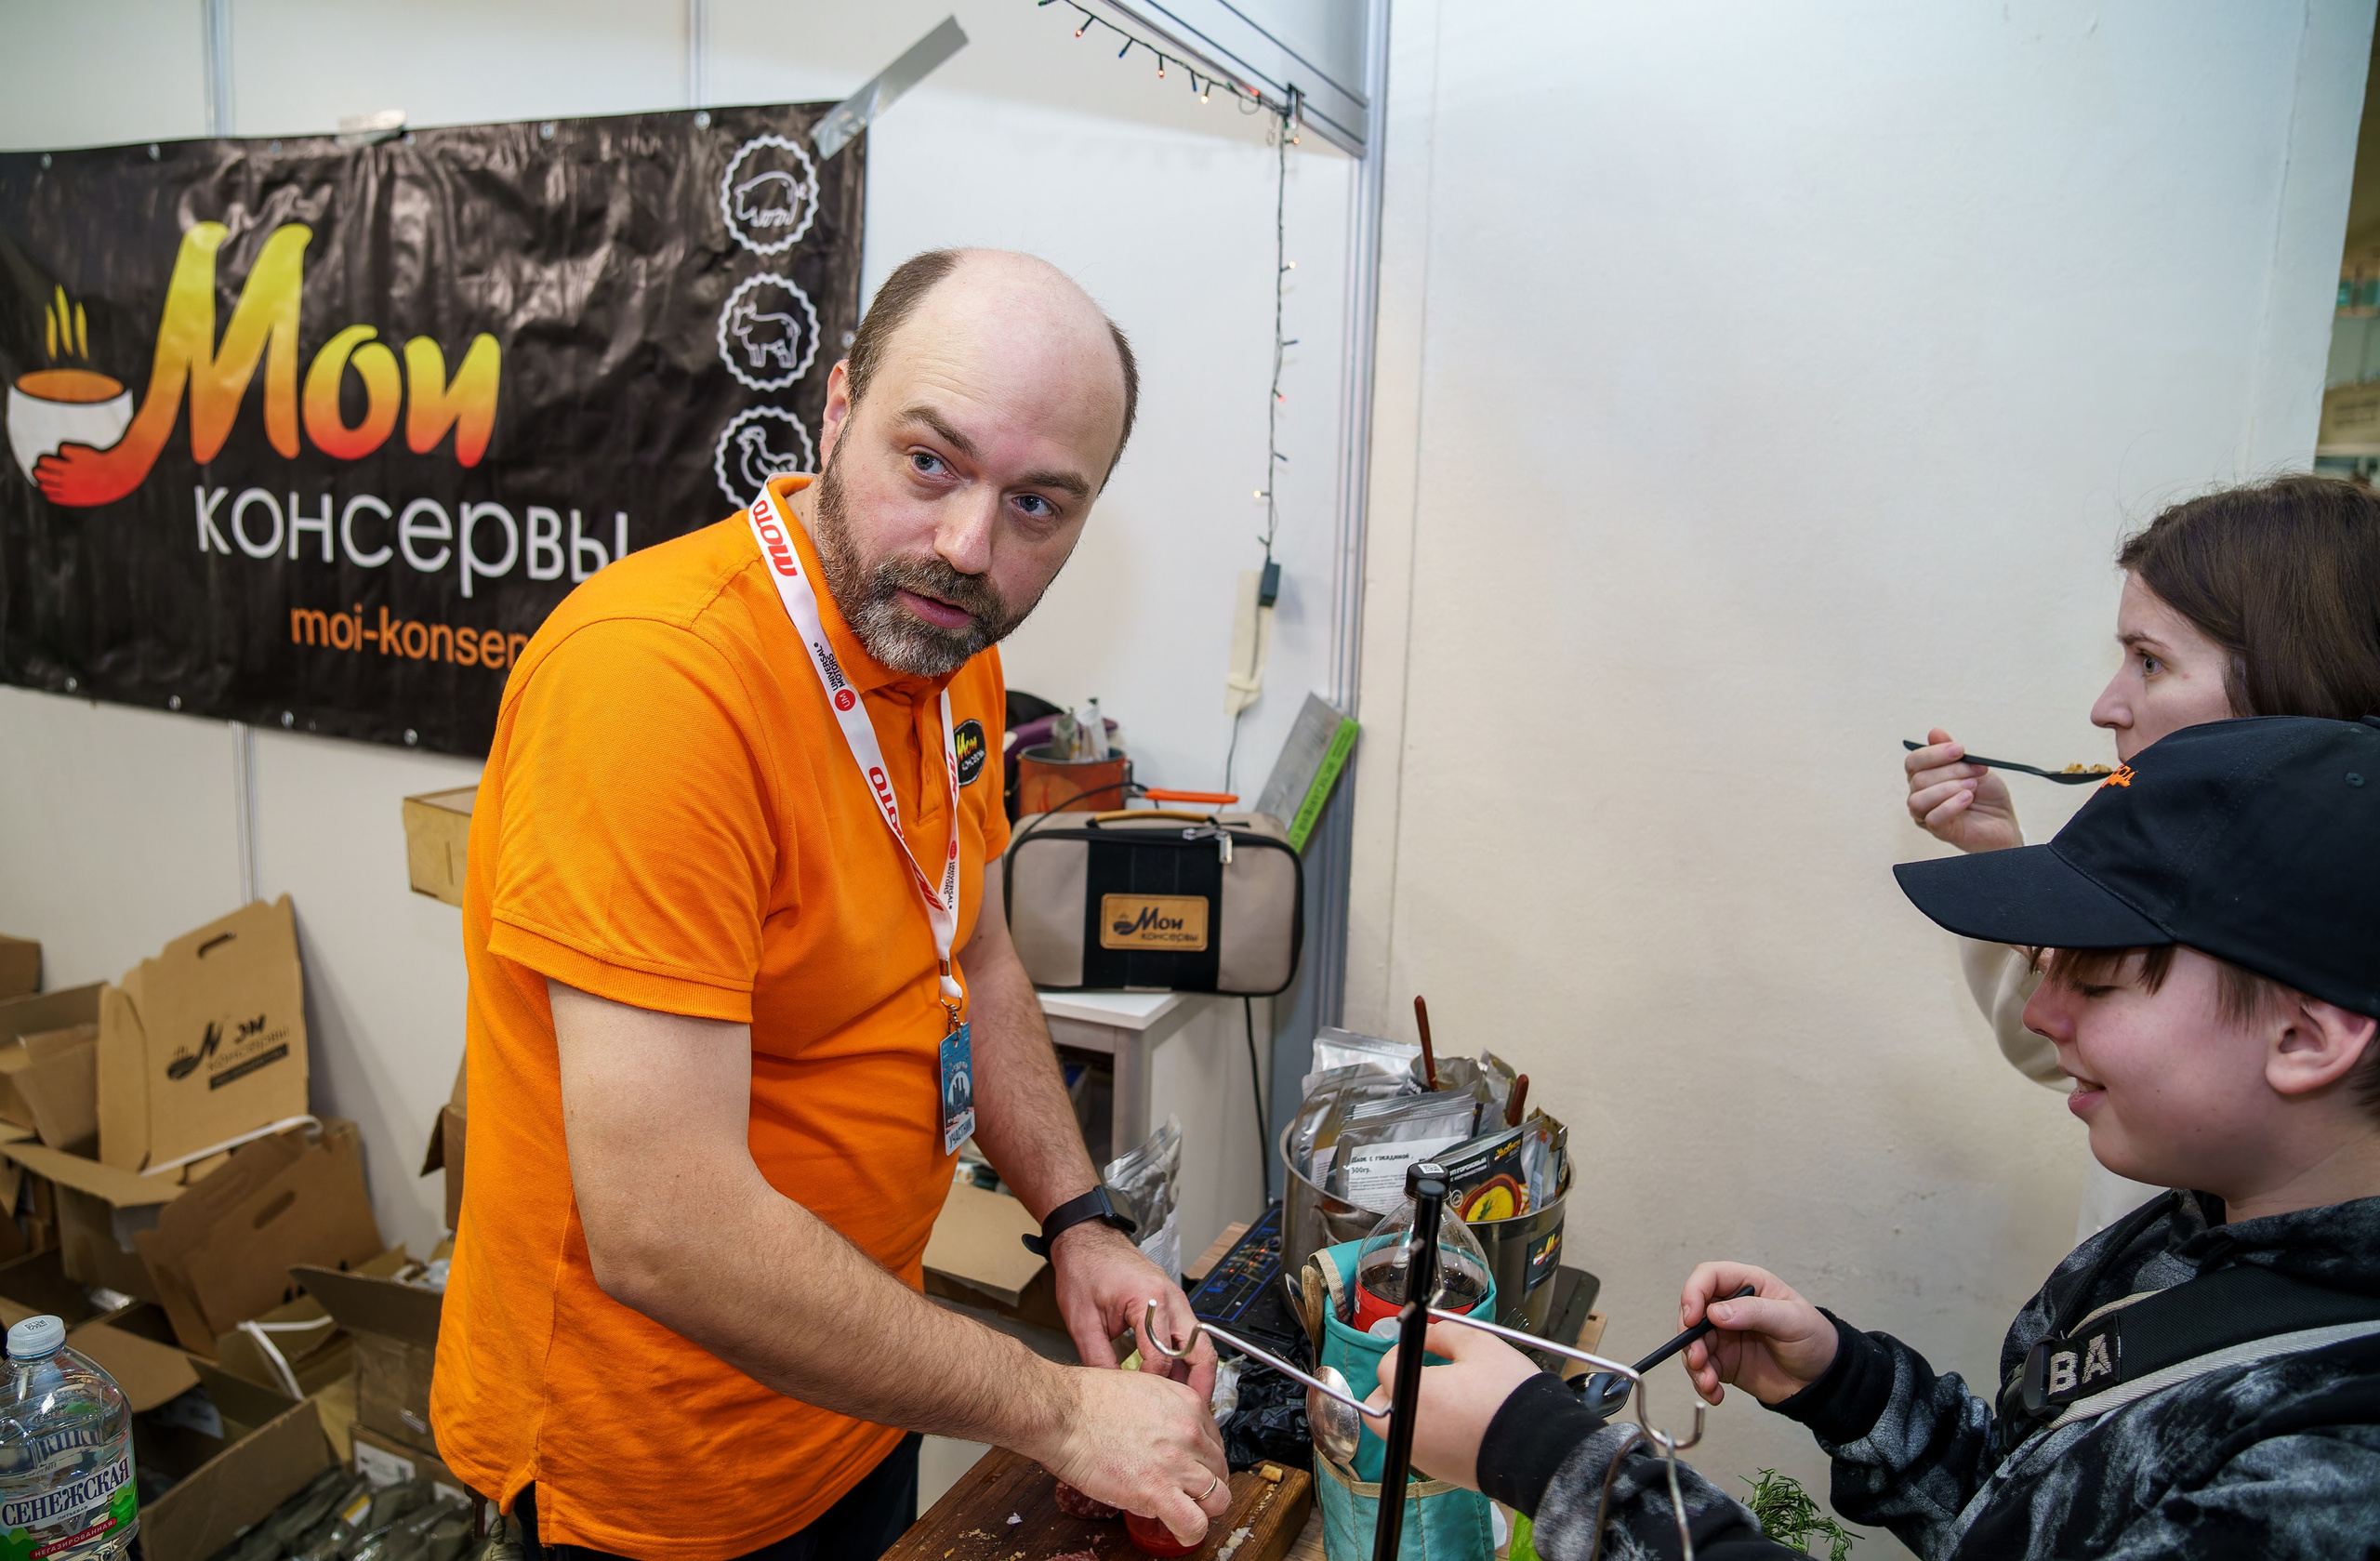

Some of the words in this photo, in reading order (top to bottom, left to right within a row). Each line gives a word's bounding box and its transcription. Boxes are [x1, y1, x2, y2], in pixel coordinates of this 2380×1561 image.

[193, 485, 628, 598] консервы
[826, 653, 845, 688] MOTORS
[1130, 906, 1184, 933] Мои
[2, 1456, 131, 1528] СЕНЕЖСКАЯ
[34, 1519, 114, 1558] НЕГАЗИРОВАННАЯ
